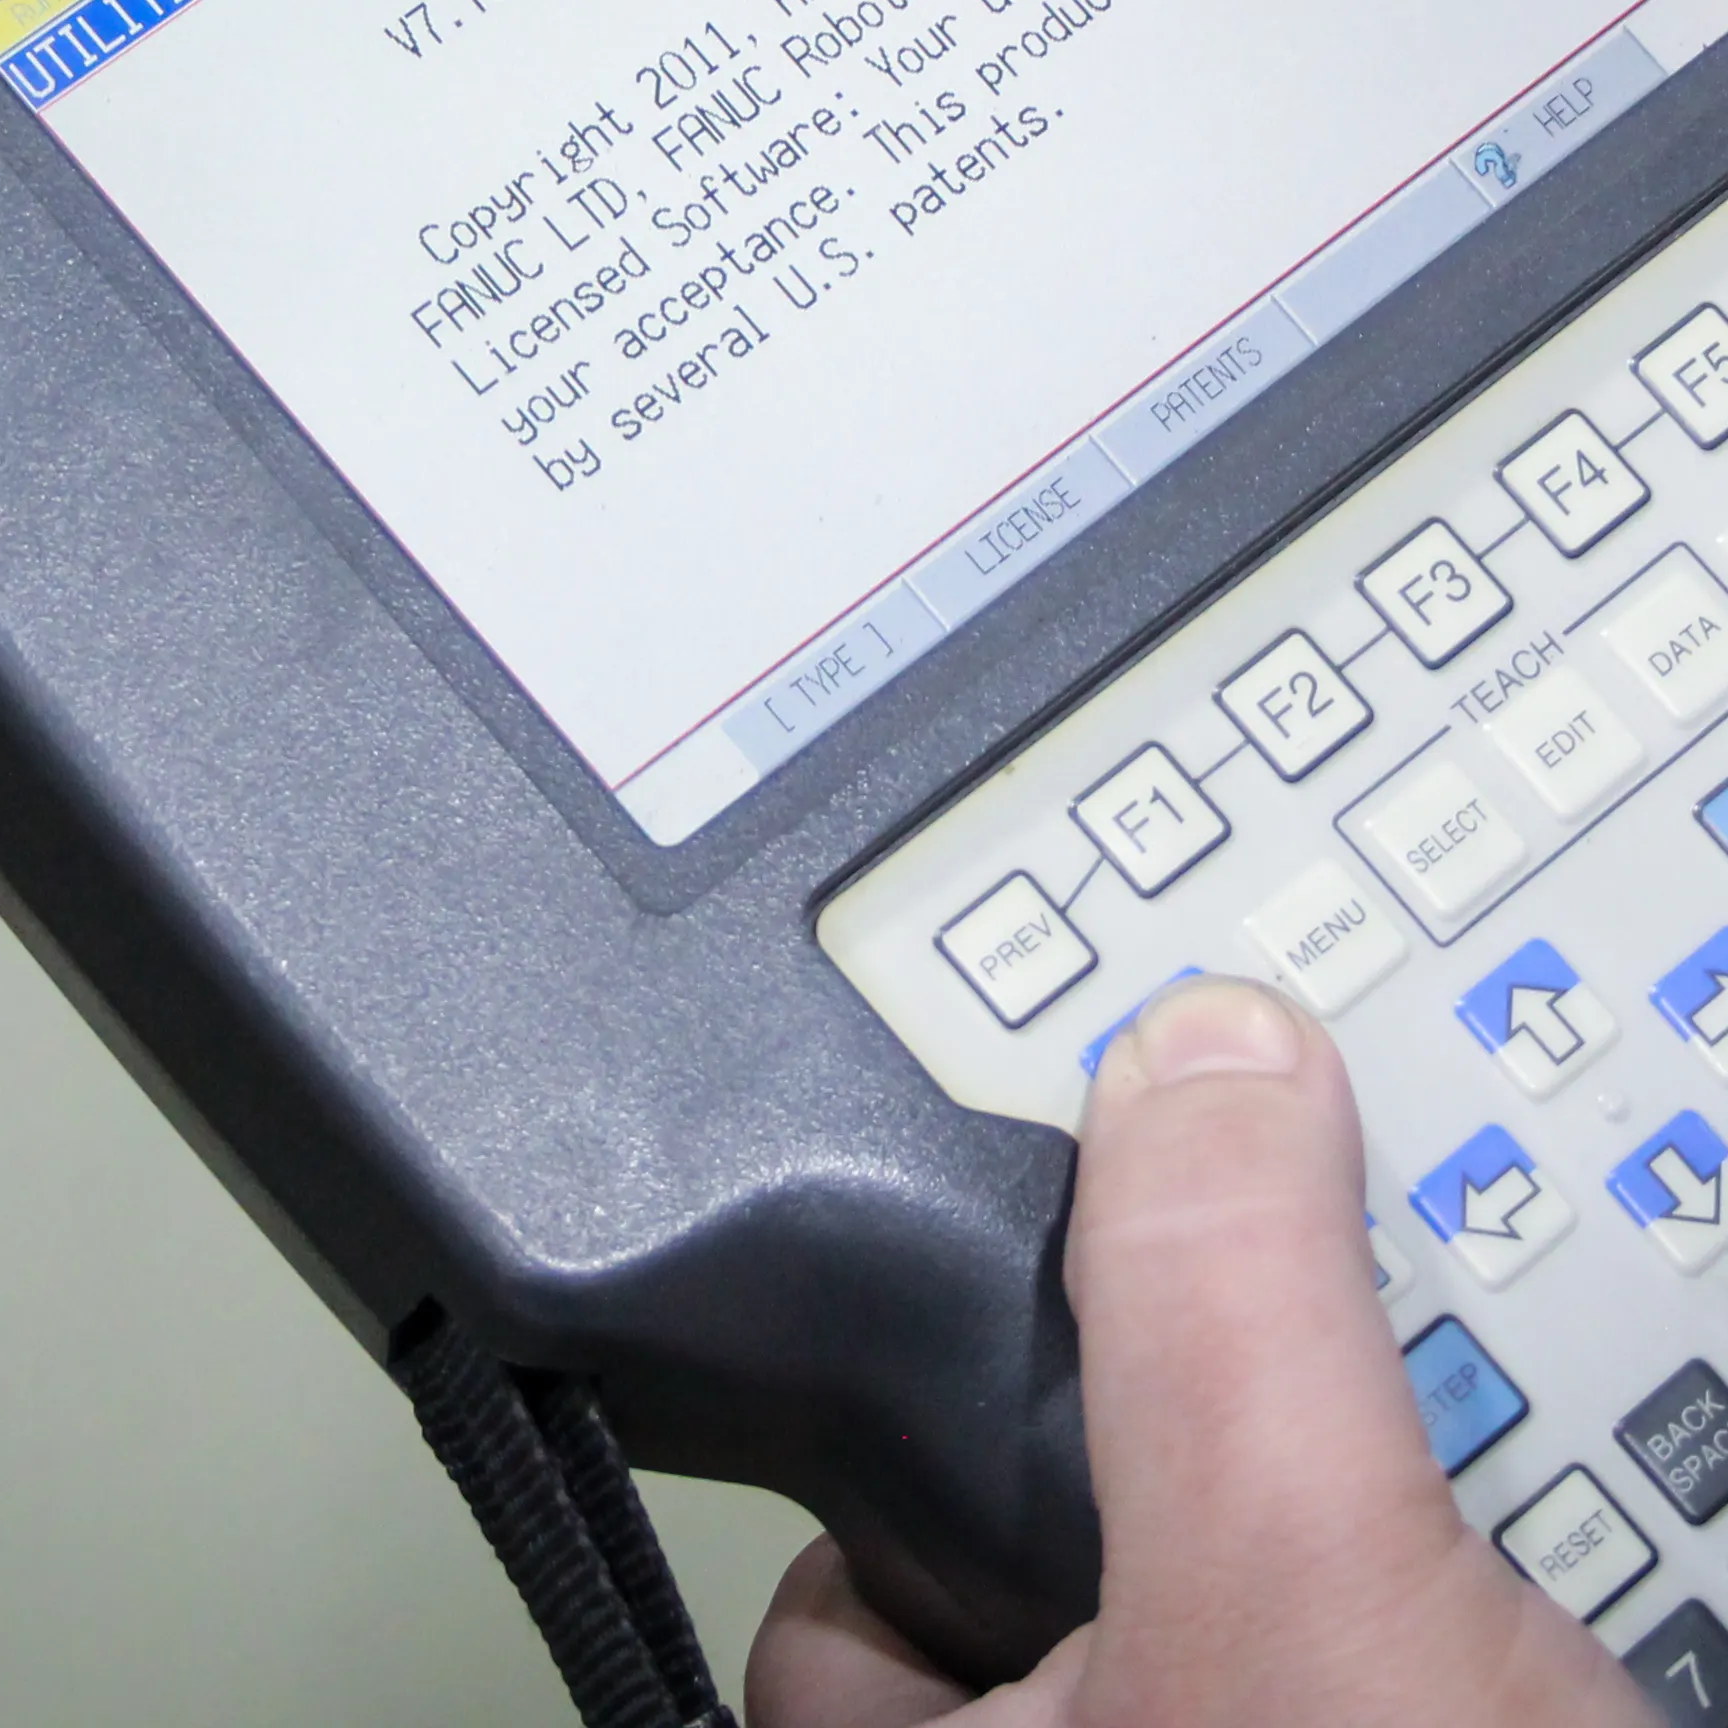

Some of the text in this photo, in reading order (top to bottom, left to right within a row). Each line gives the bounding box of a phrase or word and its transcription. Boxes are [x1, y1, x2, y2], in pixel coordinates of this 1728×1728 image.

[419, 102, 633, 264] Copyright
[637, 20, 757, 109] 2011,
[1534, 78, 1593, 137] HELP
[410, 240, 543, 348] FANUC
[544, 177, 647, 250] LTD,
[652, 66, 781, 171] FANUC
[452, 237, 651, 395] Licensed
[652, 92, 858, 247] Software:
[864, 15, 957, 86] Your
[502, 361, 590, 445] your
[615, 185, 854, 359] acceptance.
[863, 92, 966, 163] This
[533, 102, 1064, 491] by several U.S. patents.
[1150, 337, 1262, 432] PATENTS
[1537, 450, 1609, 516] F4
[966, 477, 1081, 574] LICENSE
[1397, 559, 1471, 625] F3
[790, 644, 865, 708] TYPE
[1451, 630, 1565, 725] TEACH
[1648, 615, 1721, 677] DATA
[1256, 672, 1335, 739] F2
[1536, 711, 1597, 768] EDIT
[1112, 786, 1185, 854] F1
[1406, 799, 1489, 873] SELECT
[979, 915, 1054, 980] PREV
[1286, 899, 1367, 970] MENU
[1420, 1363, 1479, 1427] STEP
[1647, 1390, 1725, 1462] BACK
[1539, 1509, 1613, 1582] RESET
[1665, 1651, 1712, 1709] 7
